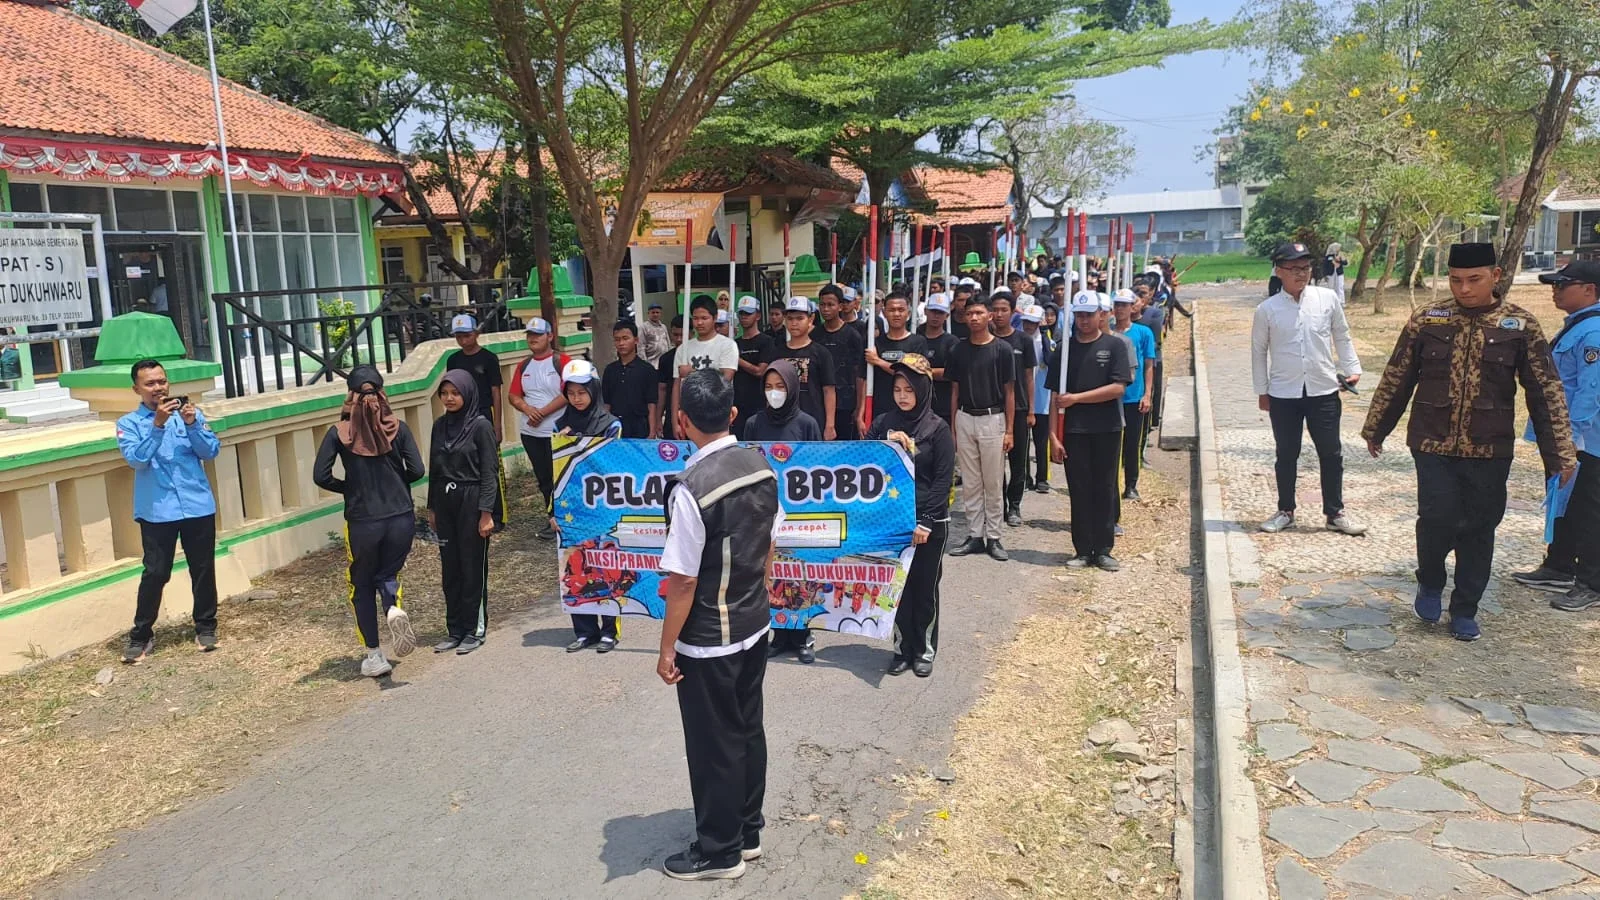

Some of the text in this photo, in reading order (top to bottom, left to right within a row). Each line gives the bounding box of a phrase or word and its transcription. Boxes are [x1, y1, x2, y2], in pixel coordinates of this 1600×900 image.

[10, 238, 26, 248] AKTA
[26, 238, 46, 247] TANAH
[46, 238, 79, 247] SEMENTARA
[10, 281, 82, 303] DUKUHWARU
[786, 467, 884, 501] BPBD
[798, 523, 828, 533] cepat
[587, 551, 616, 568] AKSI
[807, 564, 896, 584] DUKUHWARU
